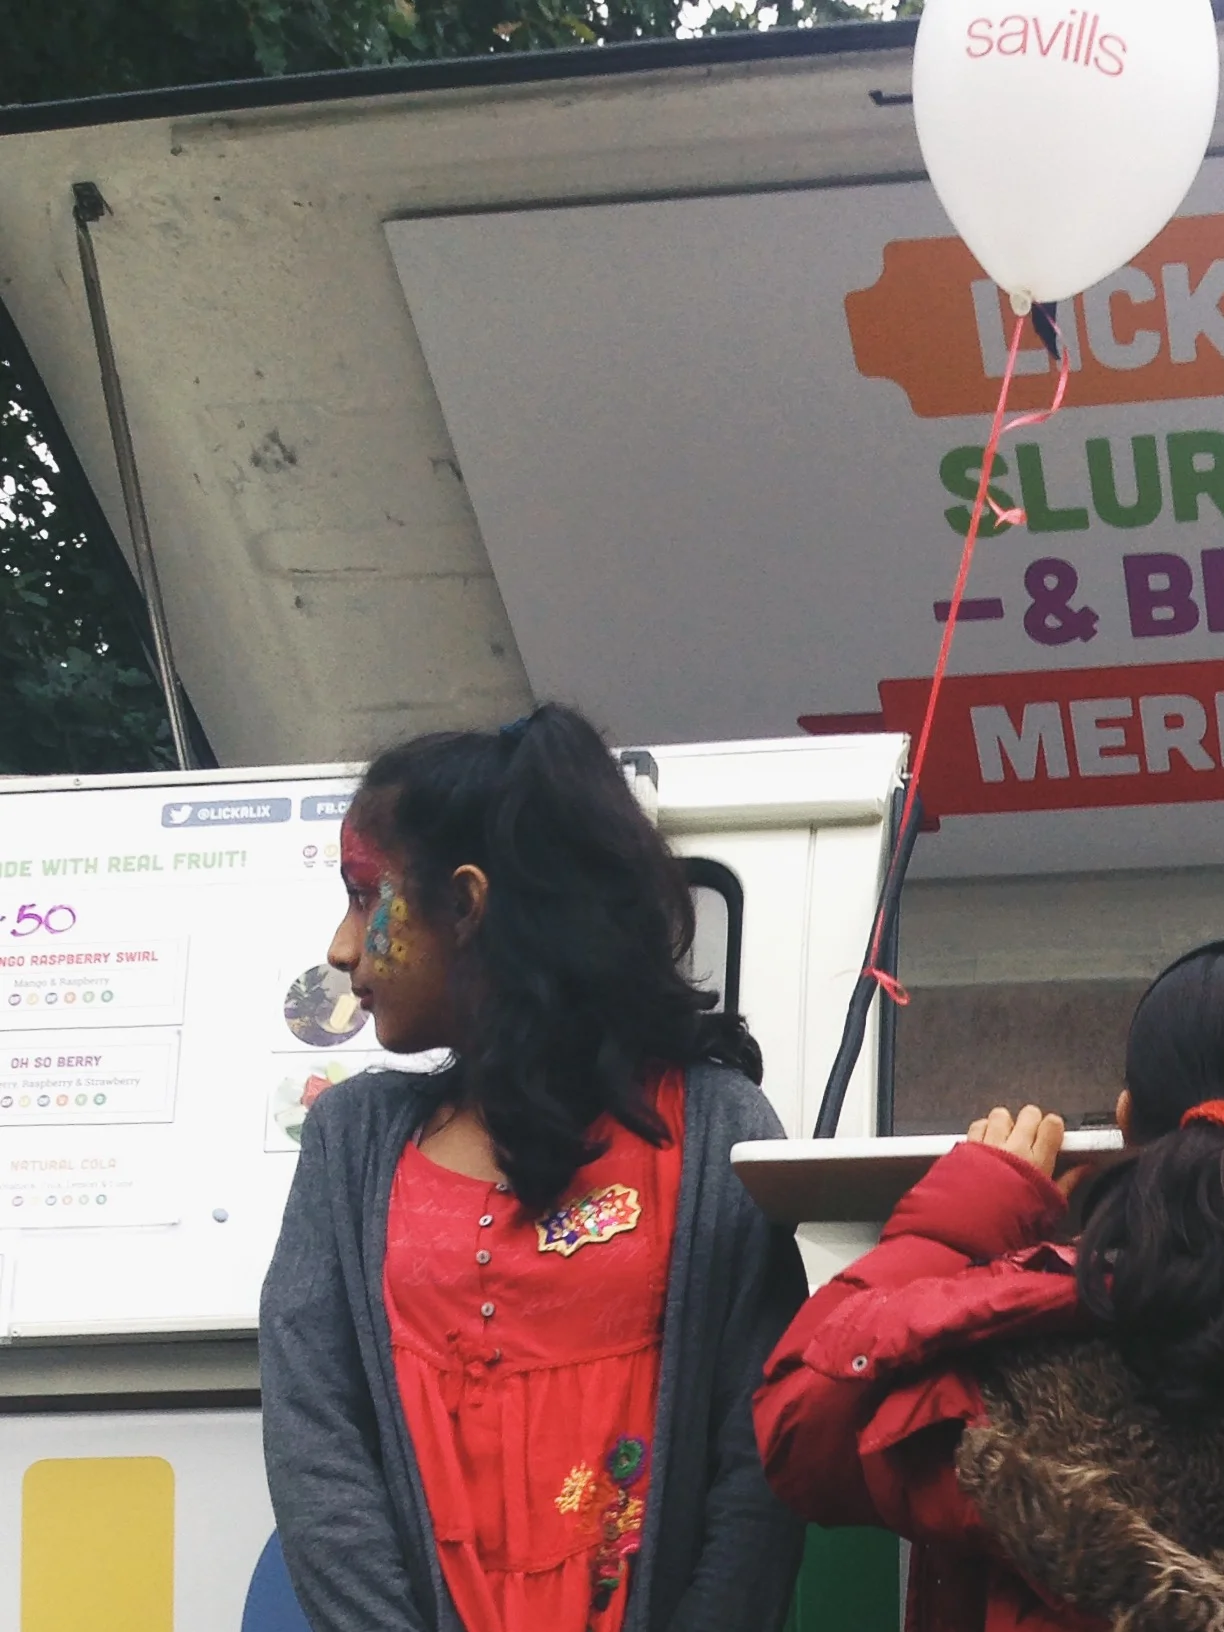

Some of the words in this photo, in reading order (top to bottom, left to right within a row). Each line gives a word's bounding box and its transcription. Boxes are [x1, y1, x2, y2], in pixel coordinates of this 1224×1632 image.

[965, 9, 1128, 77] savills
[196, 805, 272, 821] @LICKALIX
[41, 856, 99, 877] WITH
[107, 853, 165, 874] REAL
[172, 850, 248, 871] FRUIT!
[30, 952, 111, 966] RASPBERRY
[116, 950, 159, 964] SWIRL
[60, 976, 110, 987] Raspberry
[11, 1057, 29, 1069] OH
[34, 1056, 52, 1069] SO
[57, 1055, 102, 1068] BERRY
[22, 1077, 73, 1090] Raspberry
[75, 1077, 83, 1087] &
[85, 1076, 141, 1088] Strawberry
[10, 1159, 75, 1172] NATURAL
[80, 1157, 117, 1170] COLA
